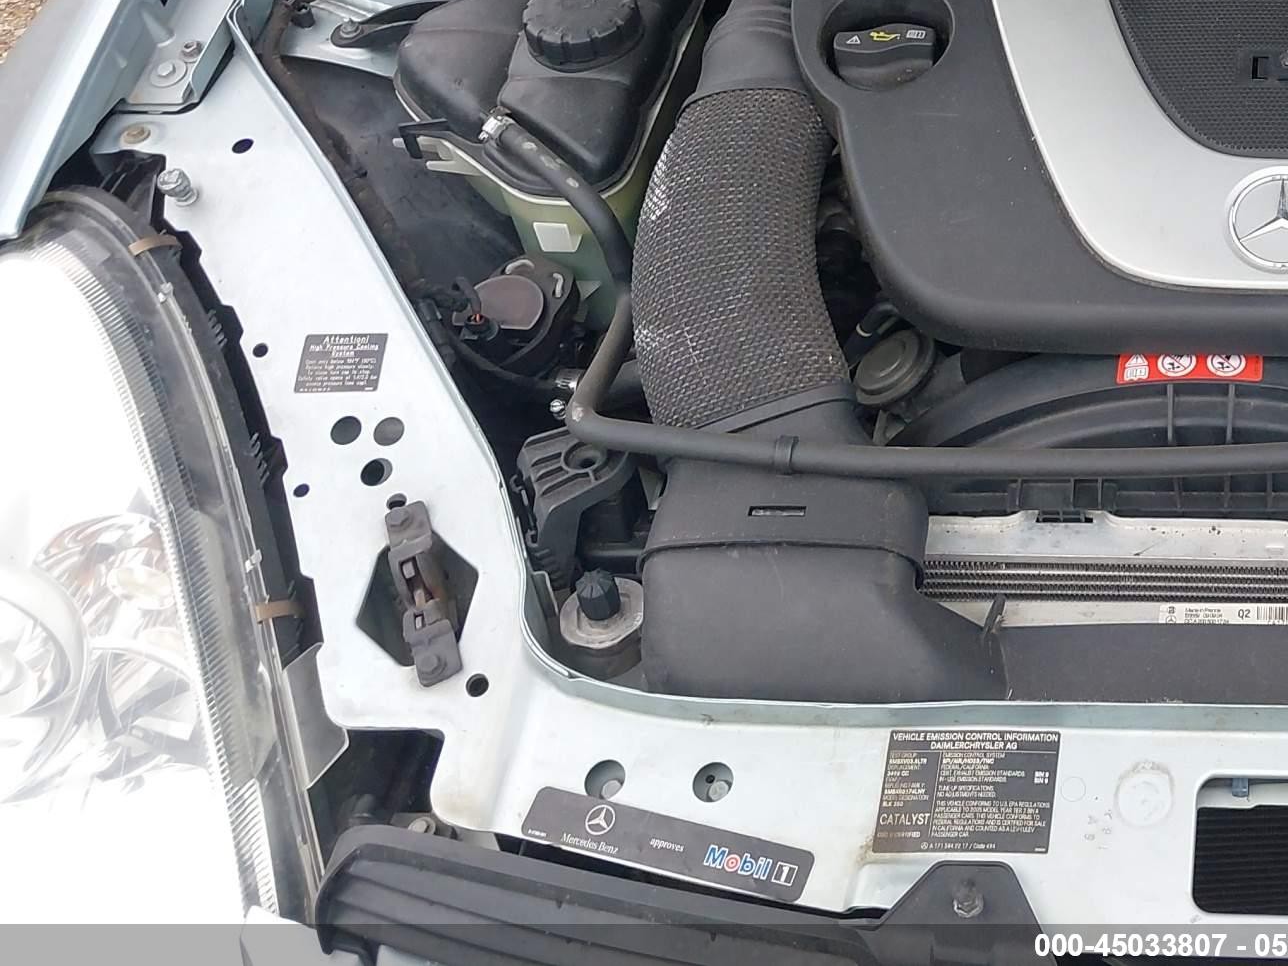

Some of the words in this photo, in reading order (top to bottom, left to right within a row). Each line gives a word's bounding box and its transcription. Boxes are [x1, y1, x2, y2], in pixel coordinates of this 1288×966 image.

[1237, 608, 1251, 619] Q2
[893, 733, 925, 741] VEHICLE
[926, 733, 963, 741] EMISSION
[965, 733, 1002, 741] CONTROL
[1004, 733, 1058, 742] INFORMATION
[930, 741, 1004, 749] DAIMLERCHRYSLER
[1006, 742, 1017, 750] AG
[880, 813, 930, 825] CATALYST
[650, 837, 684, 853] approves
[704, 845, 772, 880] Mobil
